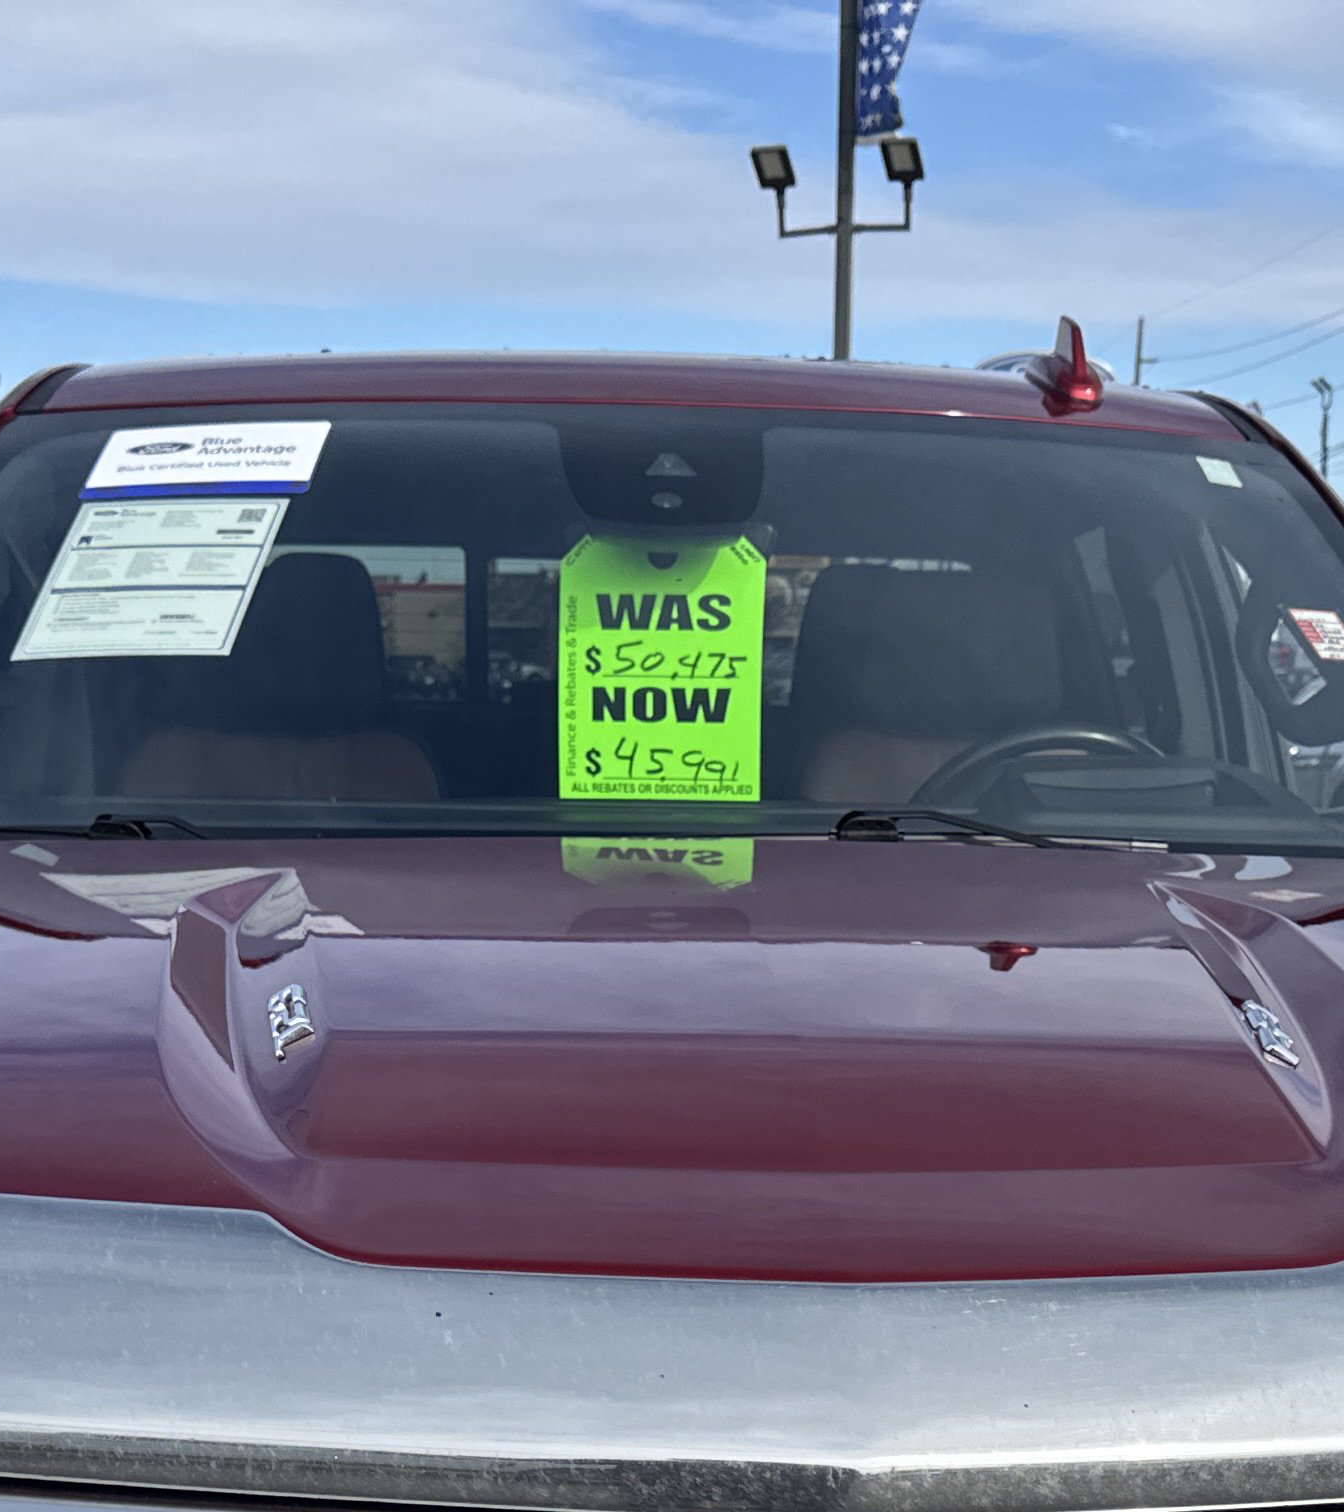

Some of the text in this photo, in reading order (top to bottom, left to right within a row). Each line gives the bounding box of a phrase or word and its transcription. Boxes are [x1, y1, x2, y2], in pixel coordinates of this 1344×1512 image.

[201, 437, 243, 447] Blue
[197, 445, 297, 455] Advantage
[117, 459, 292, 473] Blue Certified Used Vehicle
[596, 594, 732, 632] WAS
[565, 595, 577, 777] Finance & Rebates & Trade
[592, 686, 732, 724] NOW
[571, 782, 753, 796] ALL REBATES OR DISCOUNTS APPLIED
